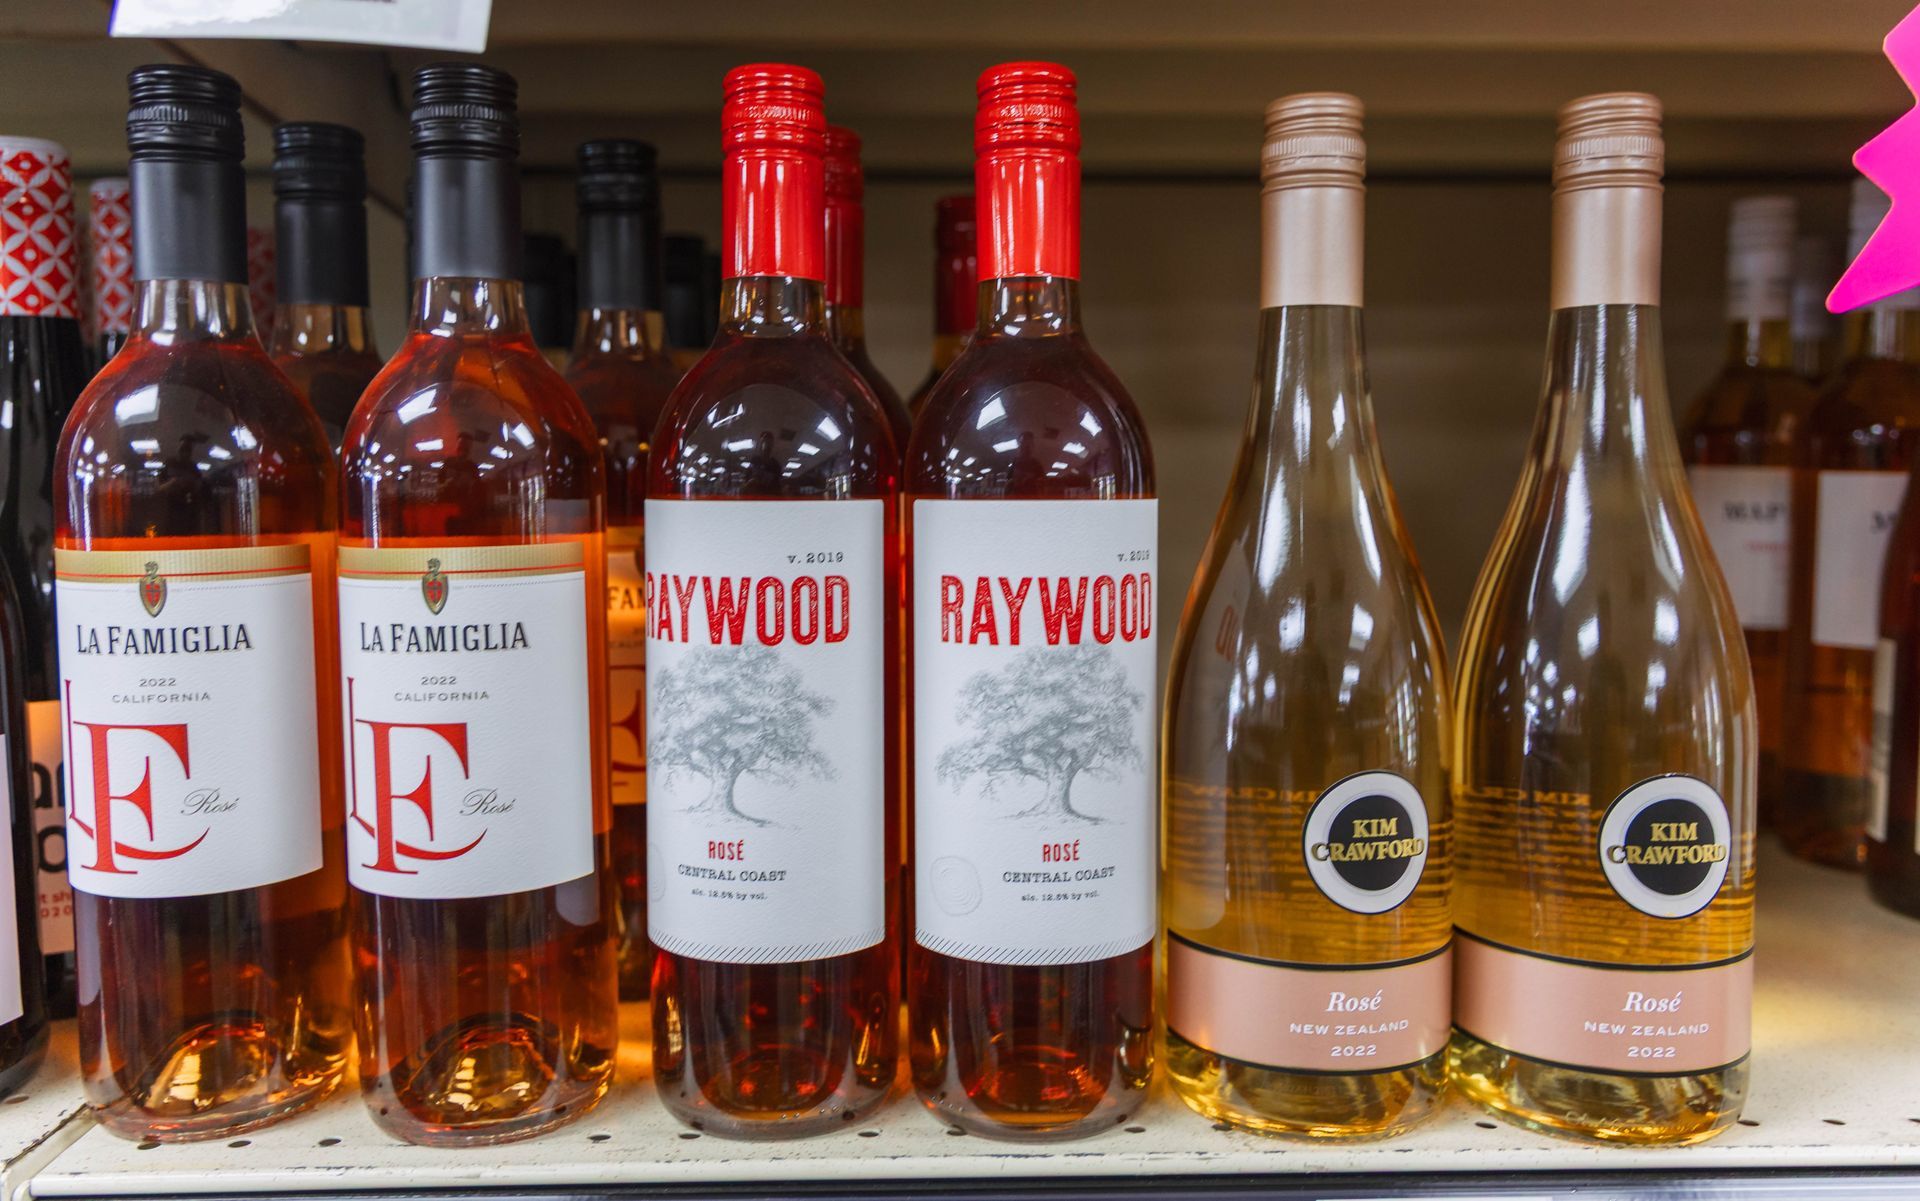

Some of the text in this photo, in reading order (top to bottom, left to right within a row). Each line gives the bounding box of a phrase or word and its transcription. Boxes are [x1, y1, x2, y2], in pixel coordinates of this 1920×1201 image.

[806, 552, 844, 563] 2019
[647, 571, 849, 646] RAYWOOD
[941, 573, 1151, 645] RAYWOOD
[77, 623, 253, 655] LA FAMIGLIA
[360, 621, 530, 653] LA FAMIGLIA
[139, 678, 177, 687] 2022
[421, 676, 457, 686] 2022
[112, 692, 211, 704] CALIFORNIA
[394, 691, 490, 702] CALIFORNIA
[180, 787, 240, 816] Rosé
[459, 787, 517, 816] Rosé
[1352, 817, 1398, 838] KIM
[1650, 822, 1698, 842] KIM
[708, 839, 744, 860] ROSÉ
[1042, 839, 1080, 862] ROSÉ
[1311, 838, 1424, 862] CRAWFORD
[1606, 843, 1727, 864] CRAWFORD
[678, 863, 787, 881] CENTRAL COAST
[1002, 866, 1115, 883] CENTRAL COAST
[1326, 989, 1383, 1012] Rosé
[1622, 991, 1682, 1012] Rosé
[1290, 1020, 1409, 1036] NEW ZEALAND
[1584, 1021, 1710, 1037] NEW ZEALAND
[1331, 1045, 1377, 1057] 2022
[1627, 1047, 1677, 1058] 2022
